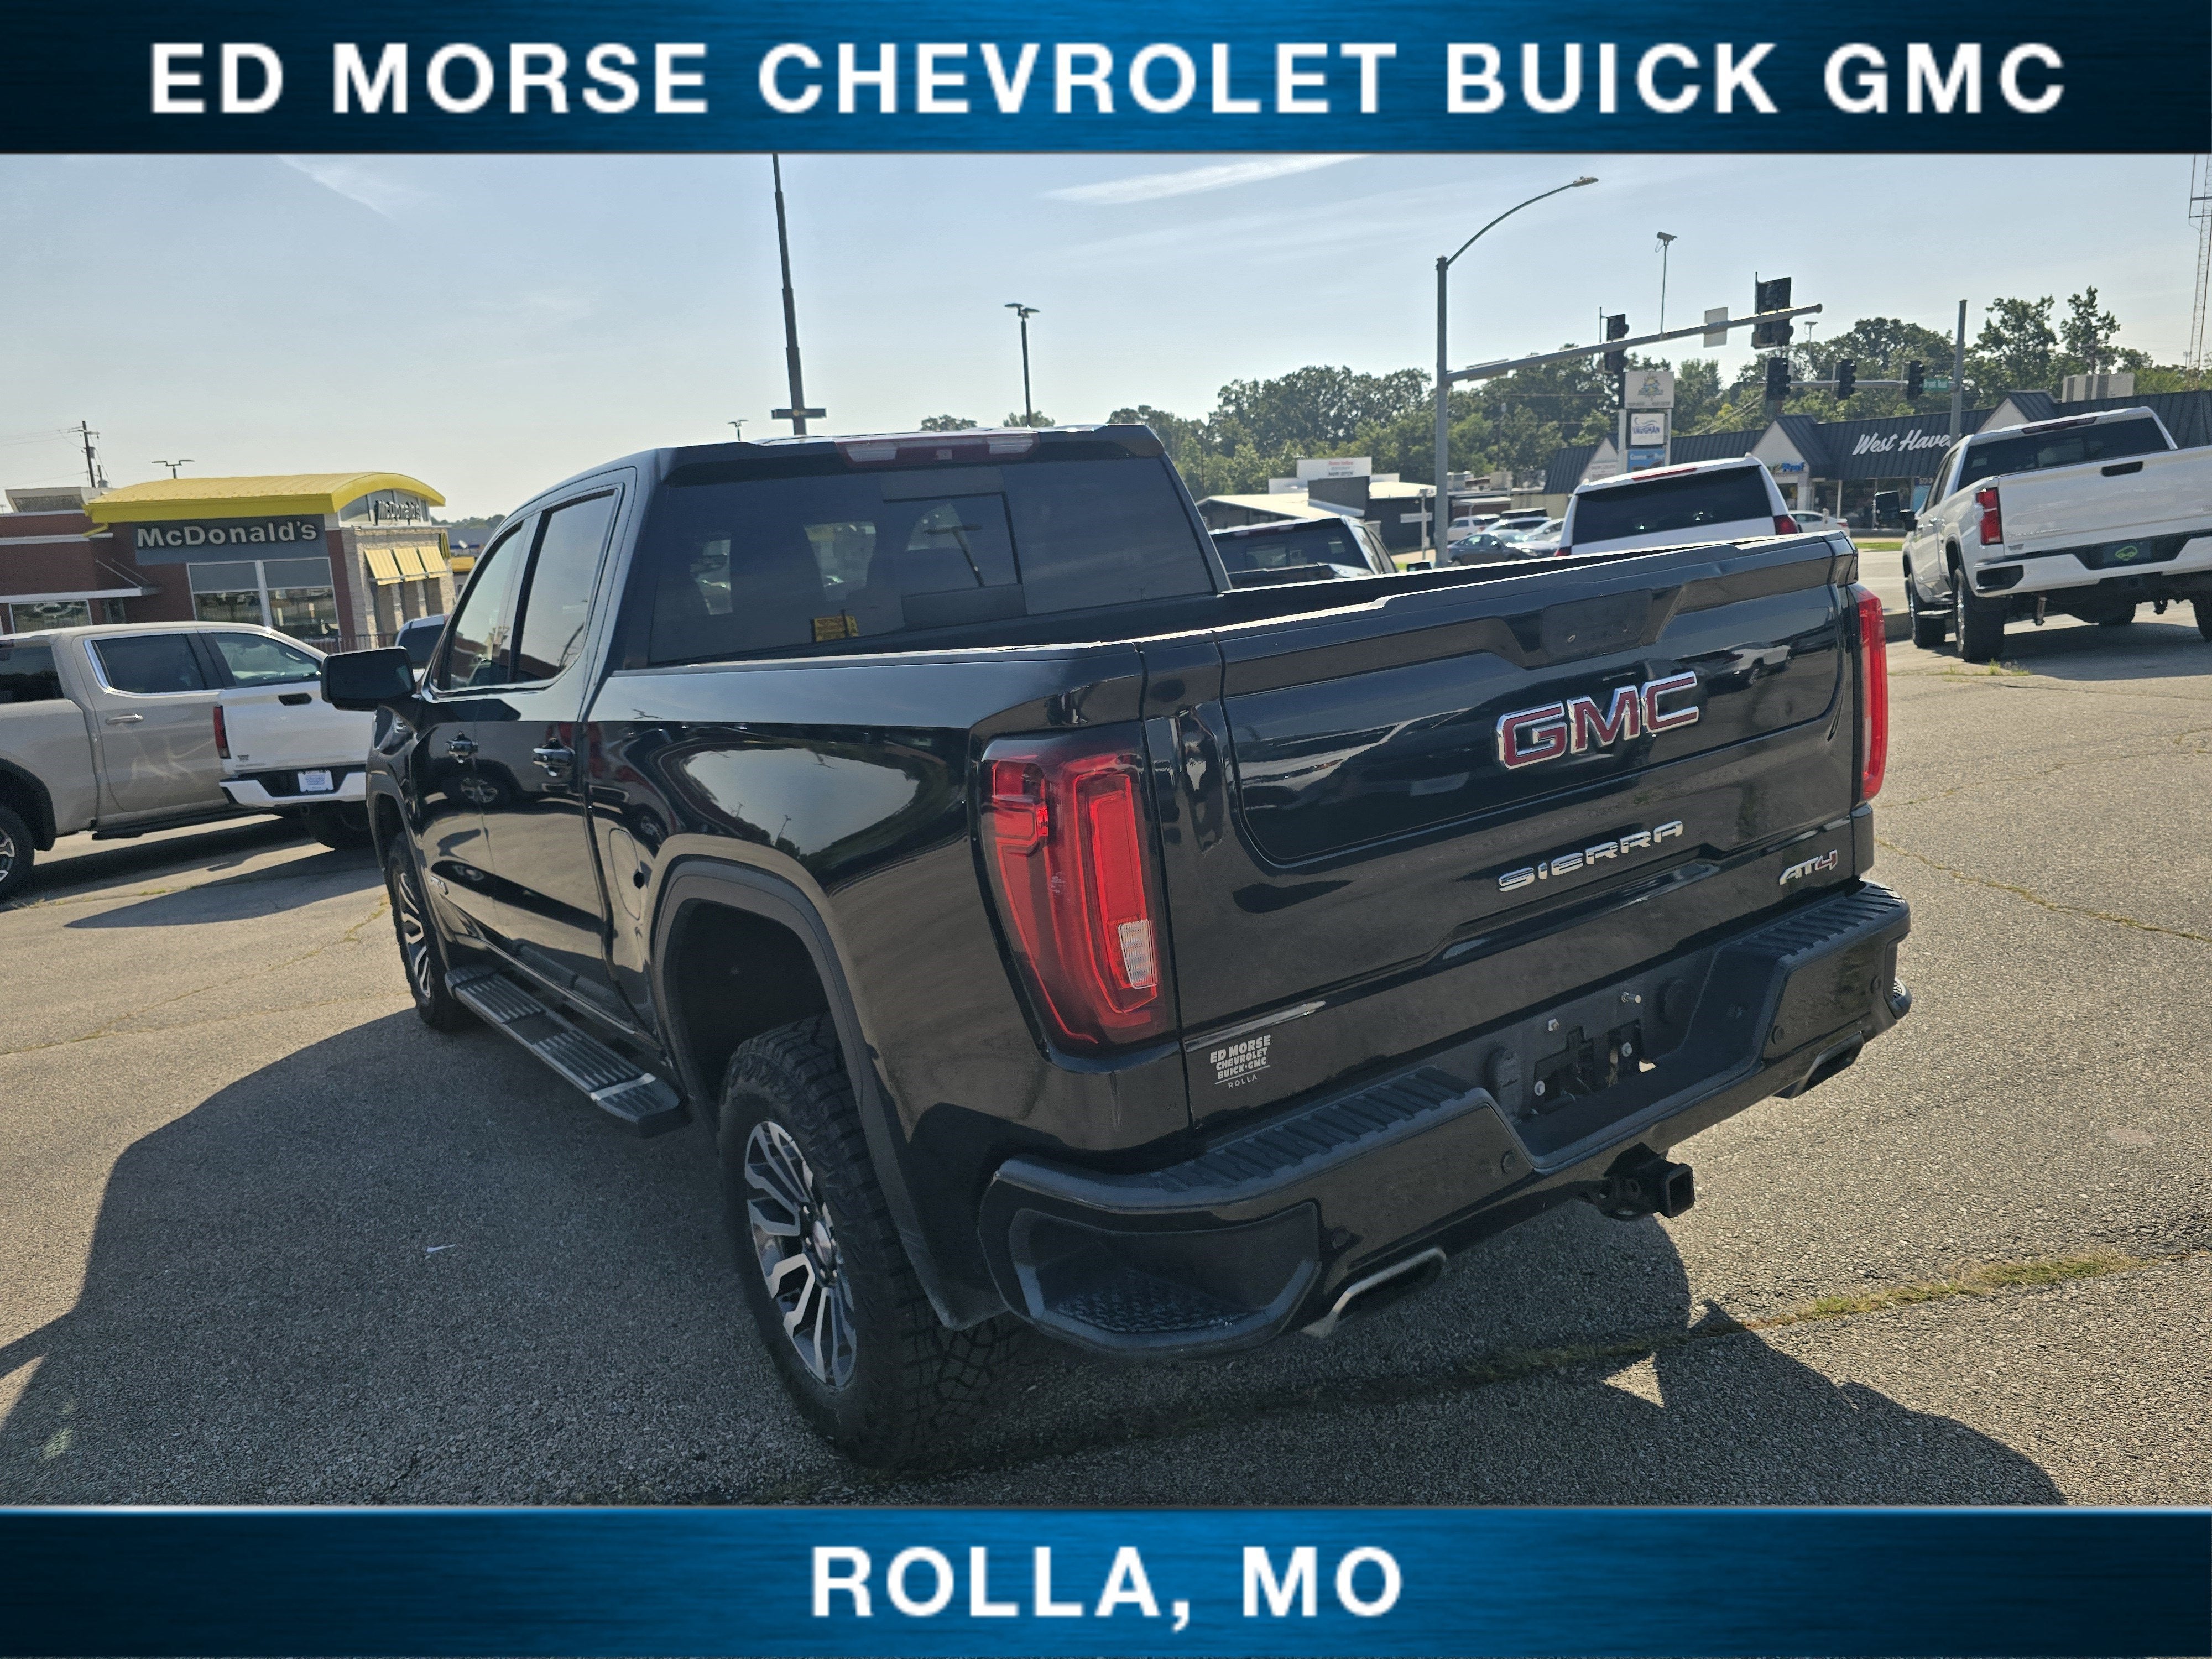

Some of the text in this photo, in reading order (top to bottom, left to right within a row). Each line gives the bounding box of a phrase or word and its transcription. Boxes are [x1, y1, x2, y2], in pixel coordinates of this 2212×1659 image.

[1852, 429, 1962, 455] West Have
[138, 521, 317, 547] McDonald's
[1496, 671, 1699, 770] GMC
[1498, 821, 1684, 893] SIERRA
[1779, 849, 1838, 886] AT4
[1210, 1034, 1271, 1063] ED MORSE
[1216, 1047, 1268, 1071] CHEVROLET
[1228, 1074, 1258, 1089] ROLLA
